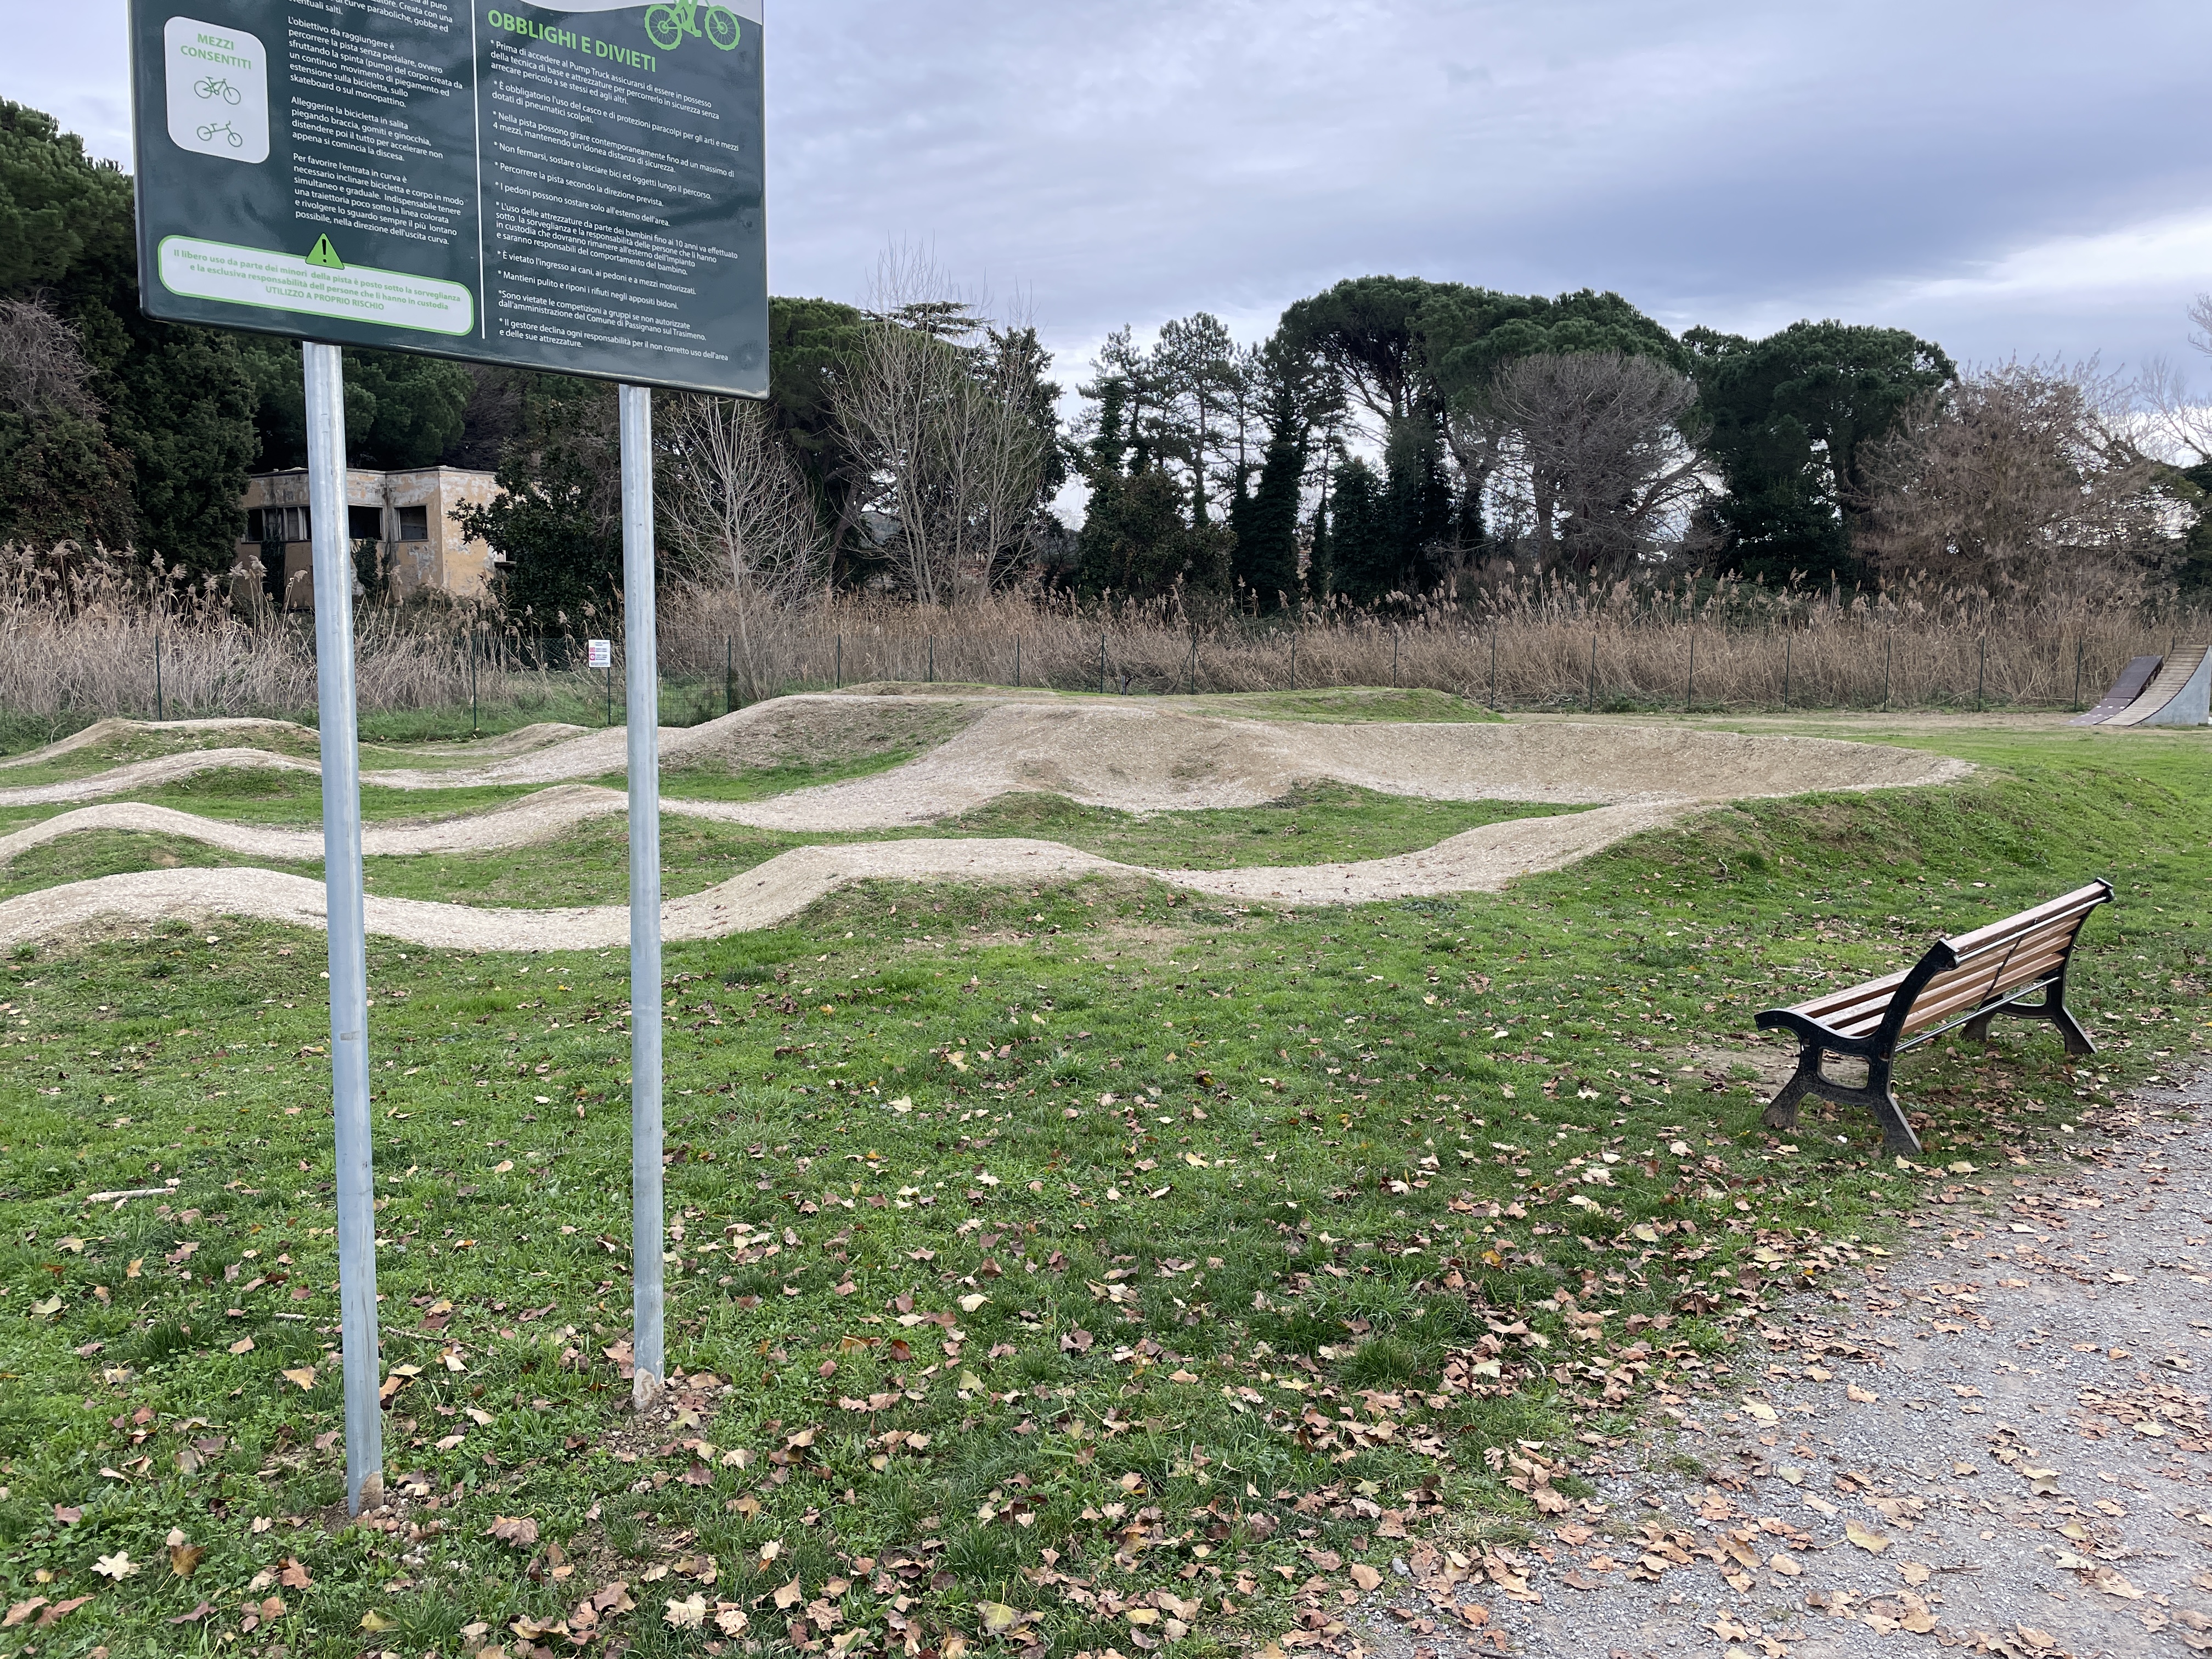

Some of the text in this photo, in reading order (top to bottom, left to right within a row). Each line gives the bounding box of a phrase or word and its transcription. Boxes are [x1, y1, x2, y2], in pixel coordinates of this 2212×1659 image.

[367, 5, 438, 30] paraboliche, gobbe
[399, 2, 422, 15] Creata
[180, 45, 251, 70] CONSENTITI
[198, 33, 234, 50] MEZZI
[288, 29, 443, 74] percorrere pedalare, ovvero
[342, 31, 388, 49] raggiungere
[488, 10, 656, 72] OBBLIGHI E DIVIETI
[289, 39, 453, 87] sfruttando spinta creata
[289, 63, 390, 93] estensione bicicletta,
[301, 55, 439, 94] continuo movimento piegamento
[490, 62, 588, 94] arrecare pericolo stessi
[496, 41, 712, 108] Prima accedere Truck assicurarsi essere possesso
[290, 74, 407, 108] skateboard monopattino.
[510, 56, 701, 115] tecnica attrezzature percorrerlo sicurezza
[291, 96, 409, 130] Alleggerire bicicletta salita
[492, 91, 594, 124] dotati pneumatici scolpiti.
[505, 84, 682, 137] obbligatorio protezioni paracolpi
[291, 108, 431, 146] piegando braccia, gomiti ginocchia,
[292, 119, 427, 156] distendere accelerare
[498, 111, 727, 176] Nella possono girare contemporaneamente massimo
[292, 132, 405, 161] appena comincia discesa.
[307, 155, 338, 169] favorire
[499, 125, 523, 137] mezzi,
[524, 131, 571, 147] mantenendo
[607, 149, 636, 163] distanza
[645, 159, 676, 173] sicurezza.
[294, 166, 404, 194] necessario inclinare bicicletta
[500, 162, 664, 207] Percorrere secondo direzione prevista.
[516, 146, 712, 200] fermarsi, sostare lasciare oggetti percorso.
[294, 176, 461, 216] simultaneo graduale. Indispensabile tenere
[311, 190, 449, 224] traiettoria colorata
[505, 185, 531, 196] pedoni
[532, 191, 563, 203] possono
[564, 198, 589, 209] sostare
[295, 211, 332, 224] possibile,
[353, 220, 389, 234] direzione
[427, 235, 449, 245] curva.
[302, 200, 457, 236] rivolgere sguardo sempre lontano
[540, 212, 738, 259] attrezzature bambini effettuato
[503, 233, 688, 275] saranno responsabili comportamento bambino.
[505, 224, 537, 235] custodia
[552, 232, 586, 245] dovranno
[588, 239, 618, 252] rimanere
[526, 218, 678, 255] sorveglianza responsabilità persone
[182, 250, 461, 302] libero parte minori posto sorveglianza
[207, 267, 448, 310] esclusiva responsabilità persone hanno custodia
[503, 270, 679, 310] Mantieni pulito riponi rifiuti appositi bidoni.
[508, 253, 534, 264] vietato
[603, 272, 627, 282] pedoni
[659, 283, 697, 295] motorizzati.
[266, 285, 304, 298] UTILIZZO
[314, 293, 350, 305] PROPRIO
[352, 299, 384, 310] RISCHIO
[522, 294, 691, 330] vietate competizioni gruppi autorizzate
[510, 321, 538, 331] gestore
[539, 324, 566, 335] declina
[584, 332, 631, 346] responsabilità
[664, 345, 690, 355] corretto
[539, 335, 583, 348] attrezzature.
[586, 313, 616, 326] Comune
[625, 320, 662, 333] Passignano
[672, 328, 707, 341] Trasimeno.
